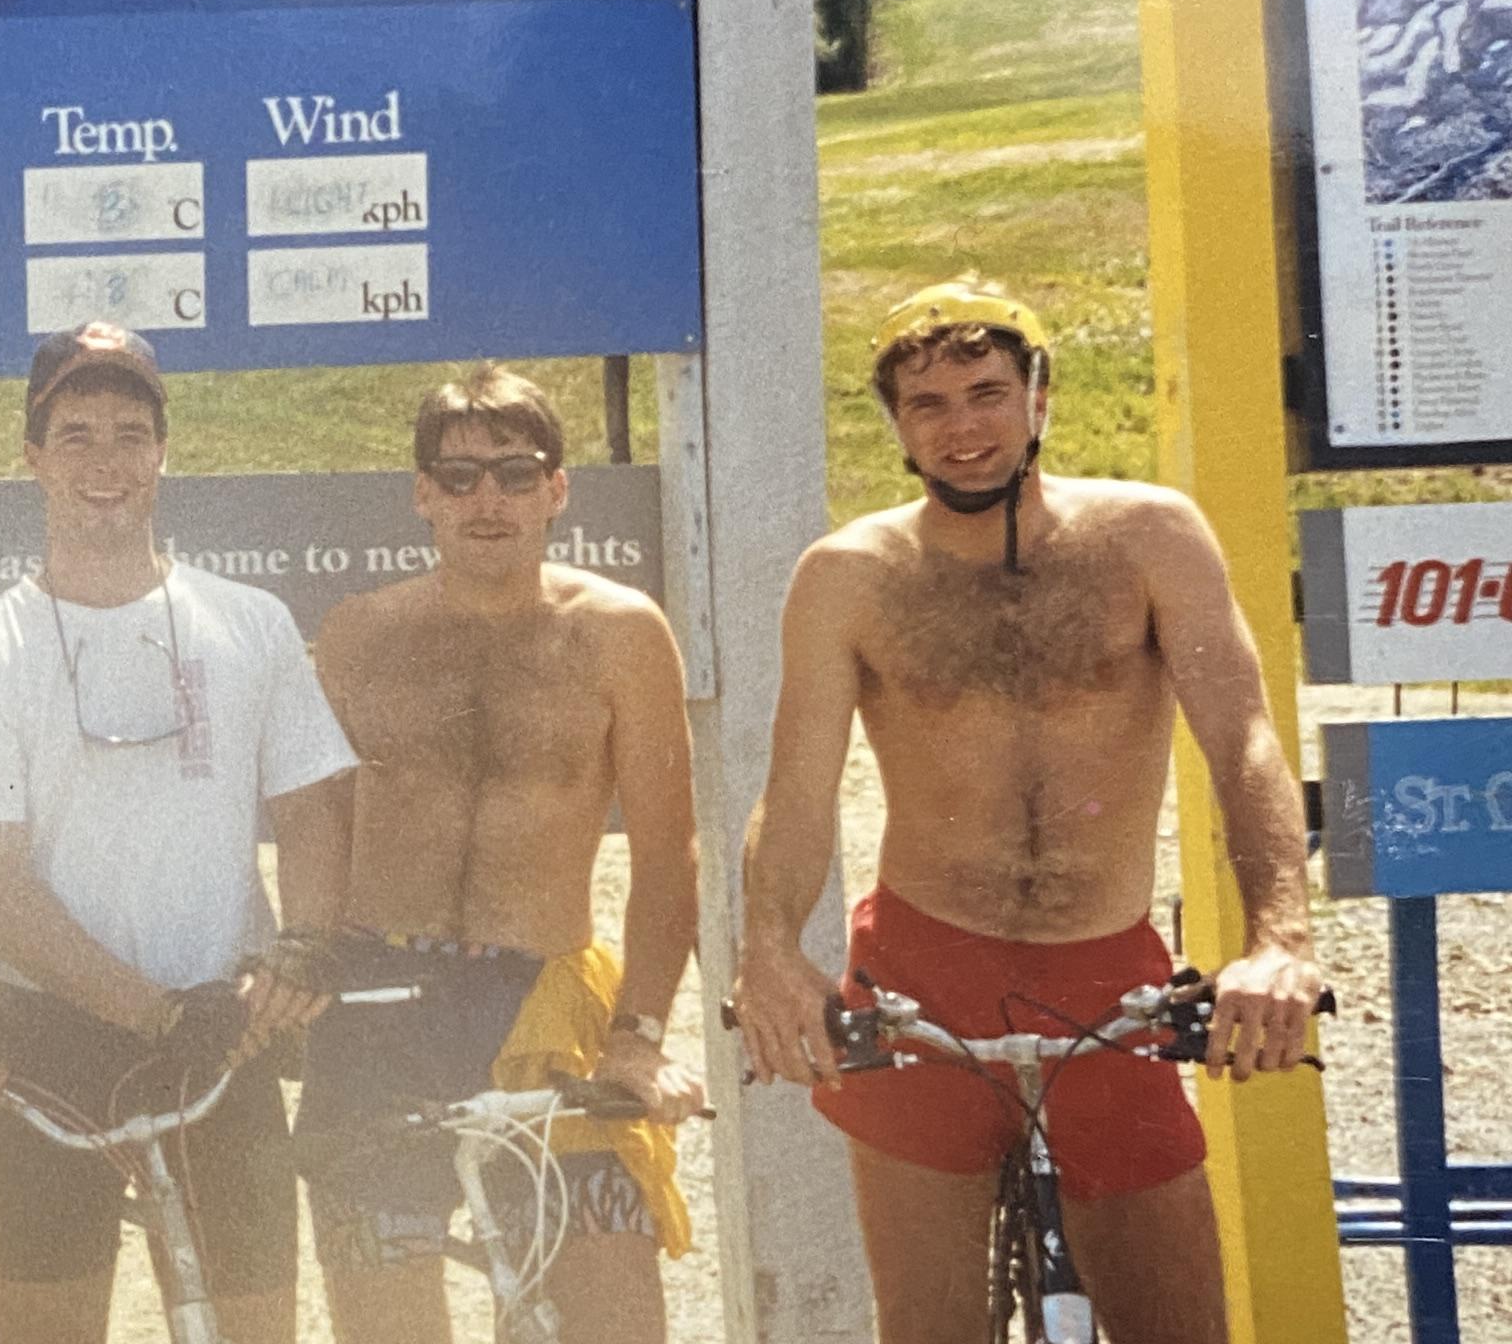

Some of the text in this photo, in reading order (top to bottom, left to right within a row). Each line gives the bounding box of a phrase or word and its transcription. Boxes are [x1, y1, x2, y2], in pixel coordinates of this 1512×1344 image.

[42, 107, 178, 163] Temp.
[265, 92, 402, 145] Wind
[363, 279, 422, 319] kph
[162, 537, 290, 575] home
[303, 544, 349, 573] to
